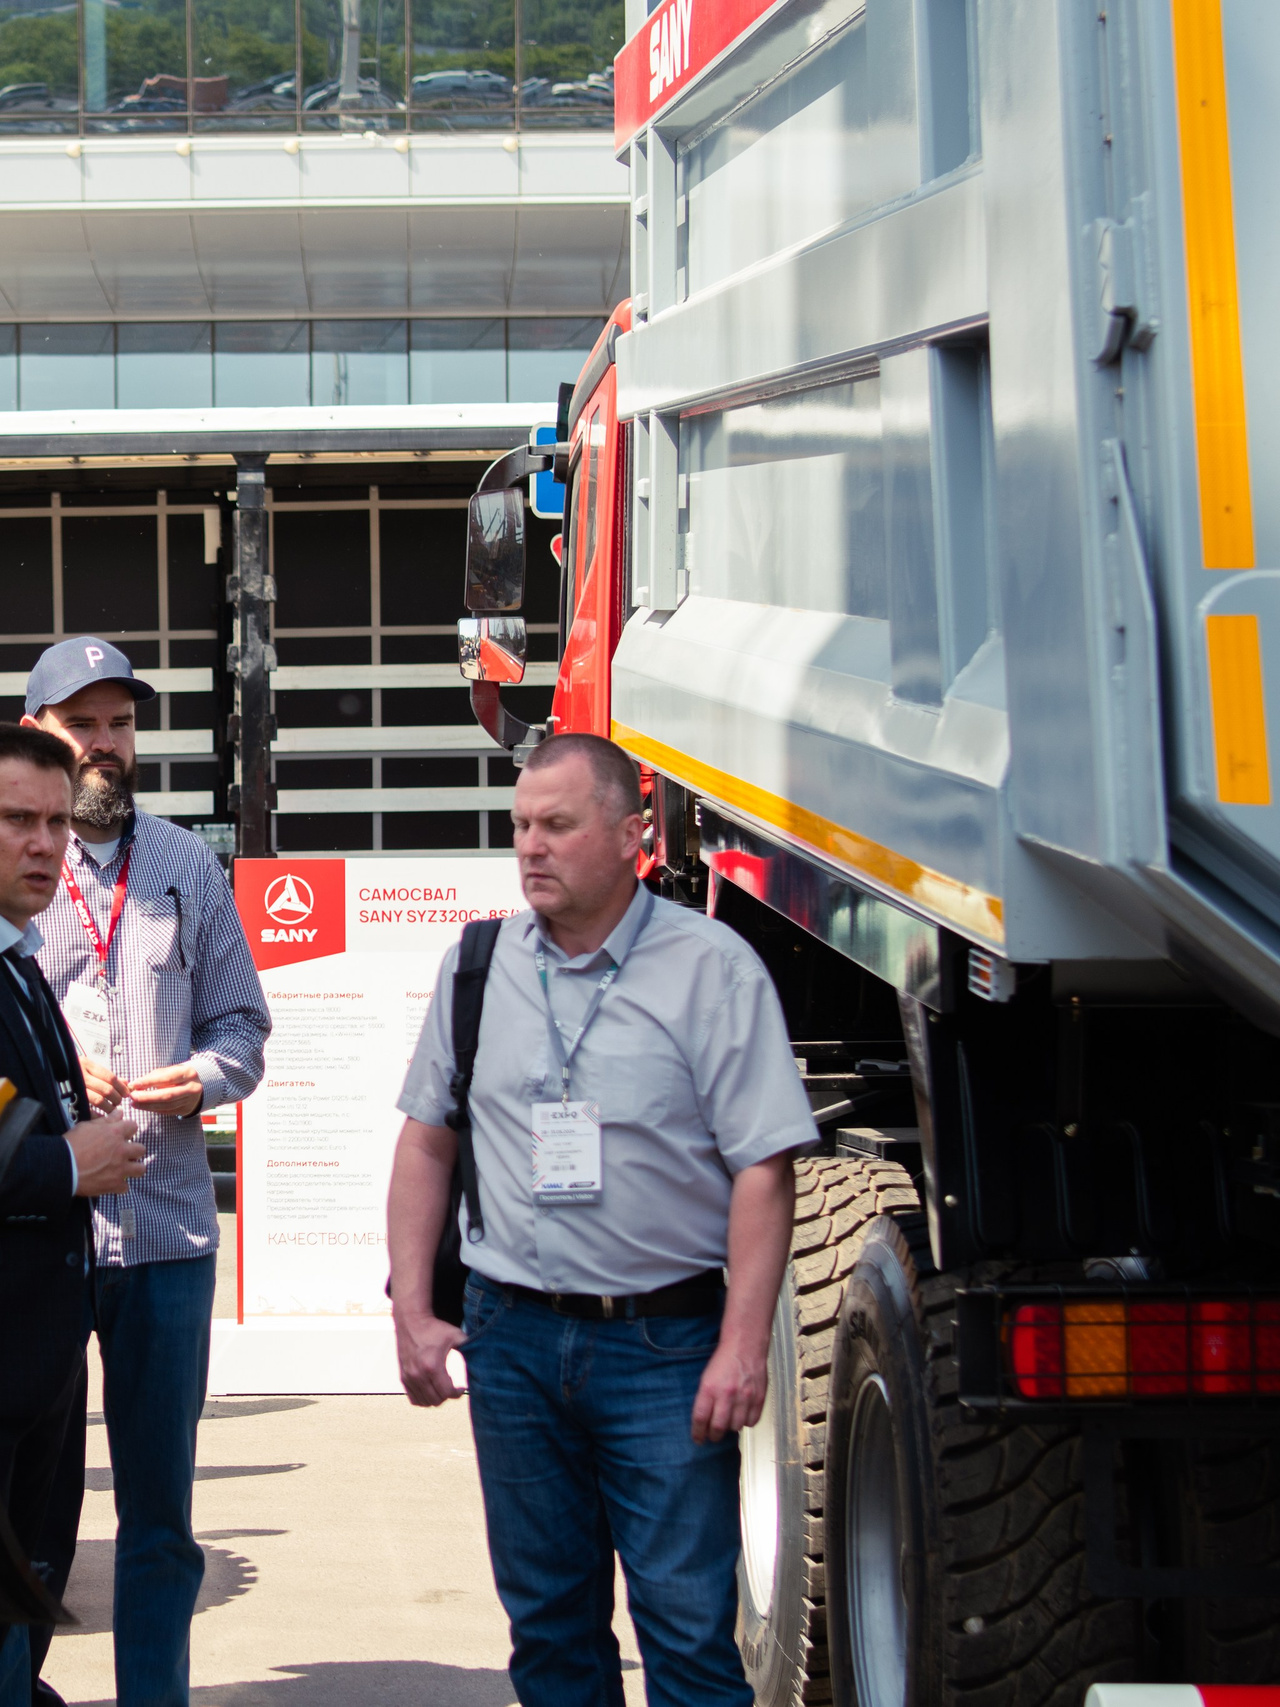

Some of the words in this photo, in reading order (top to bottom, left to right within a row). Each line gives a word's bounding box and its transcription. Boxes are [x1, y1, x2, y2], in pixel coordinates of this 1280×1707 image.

[649, 0, 693, 103] SANY
[85, 646, 104, 668] P
[358, 887, 457, 901] САМОСВАЛ
[359, 909, 403, 923] SANY
[406, 908, 520, 923] SYZ320C-8S(
[260, 928, 319, 943] SANY
[267, 992, 321, 1000] Габаритные
[323, 992, 364, 1000] размеры
[267, 1079, 316, 1088] Двигатель
[268, 1232, 349, 1246] КАЧЕСТВО
